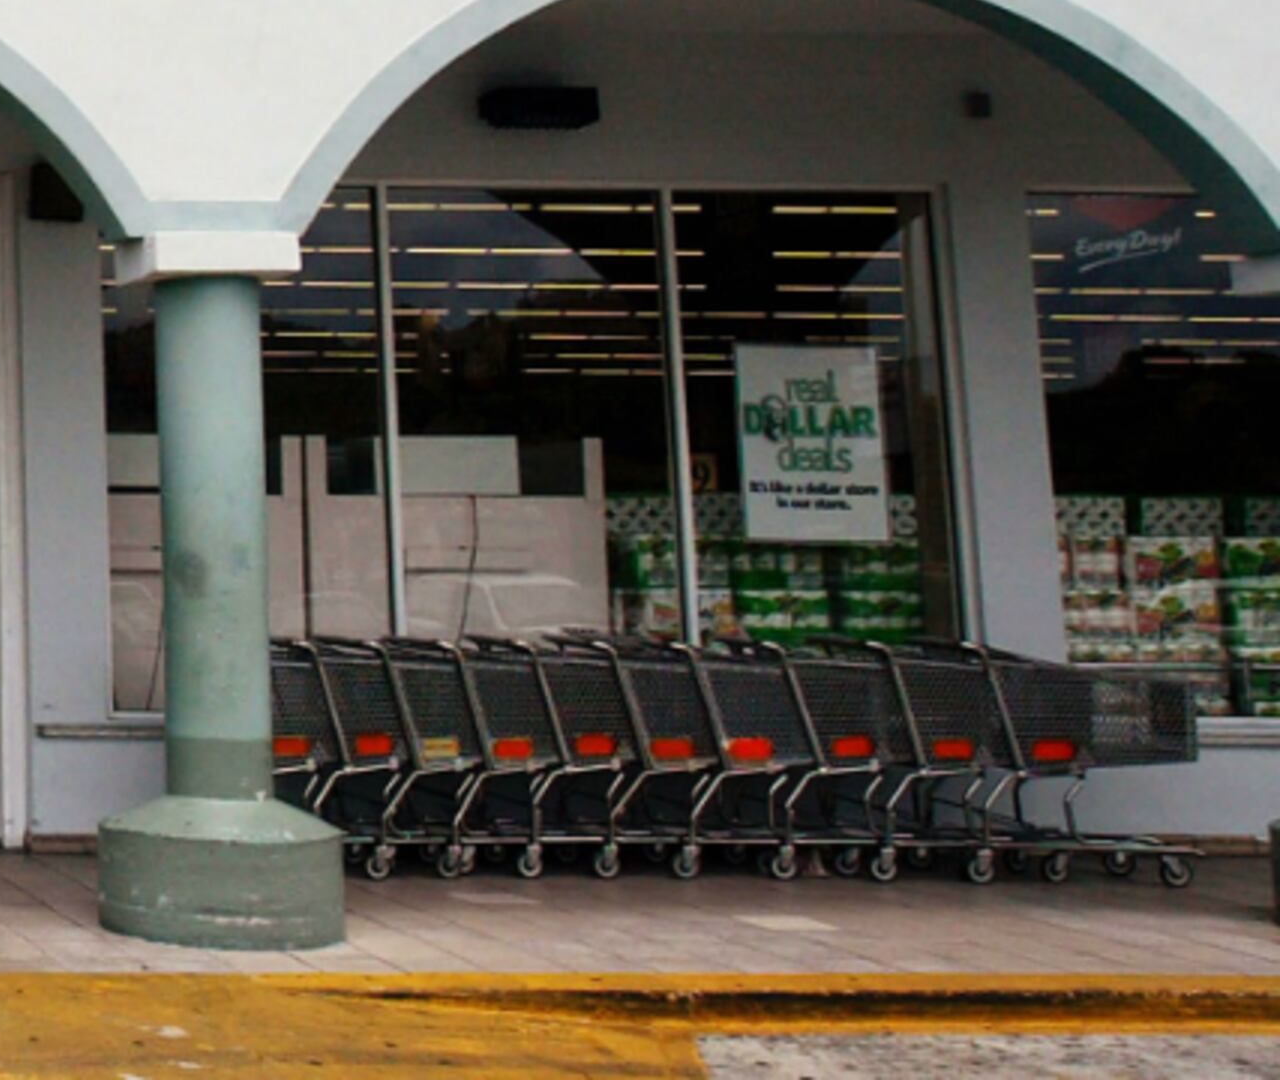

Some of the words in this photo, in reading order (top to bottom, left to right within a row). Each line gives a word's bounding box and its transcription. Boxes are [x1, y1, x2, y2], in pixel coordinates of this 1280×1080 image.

[785, 369, 840, 402] real
[743, 395, 878, 442] DOLLAR
[778, 437, 853, 473] deals
[844, 484, 879, 496] store
